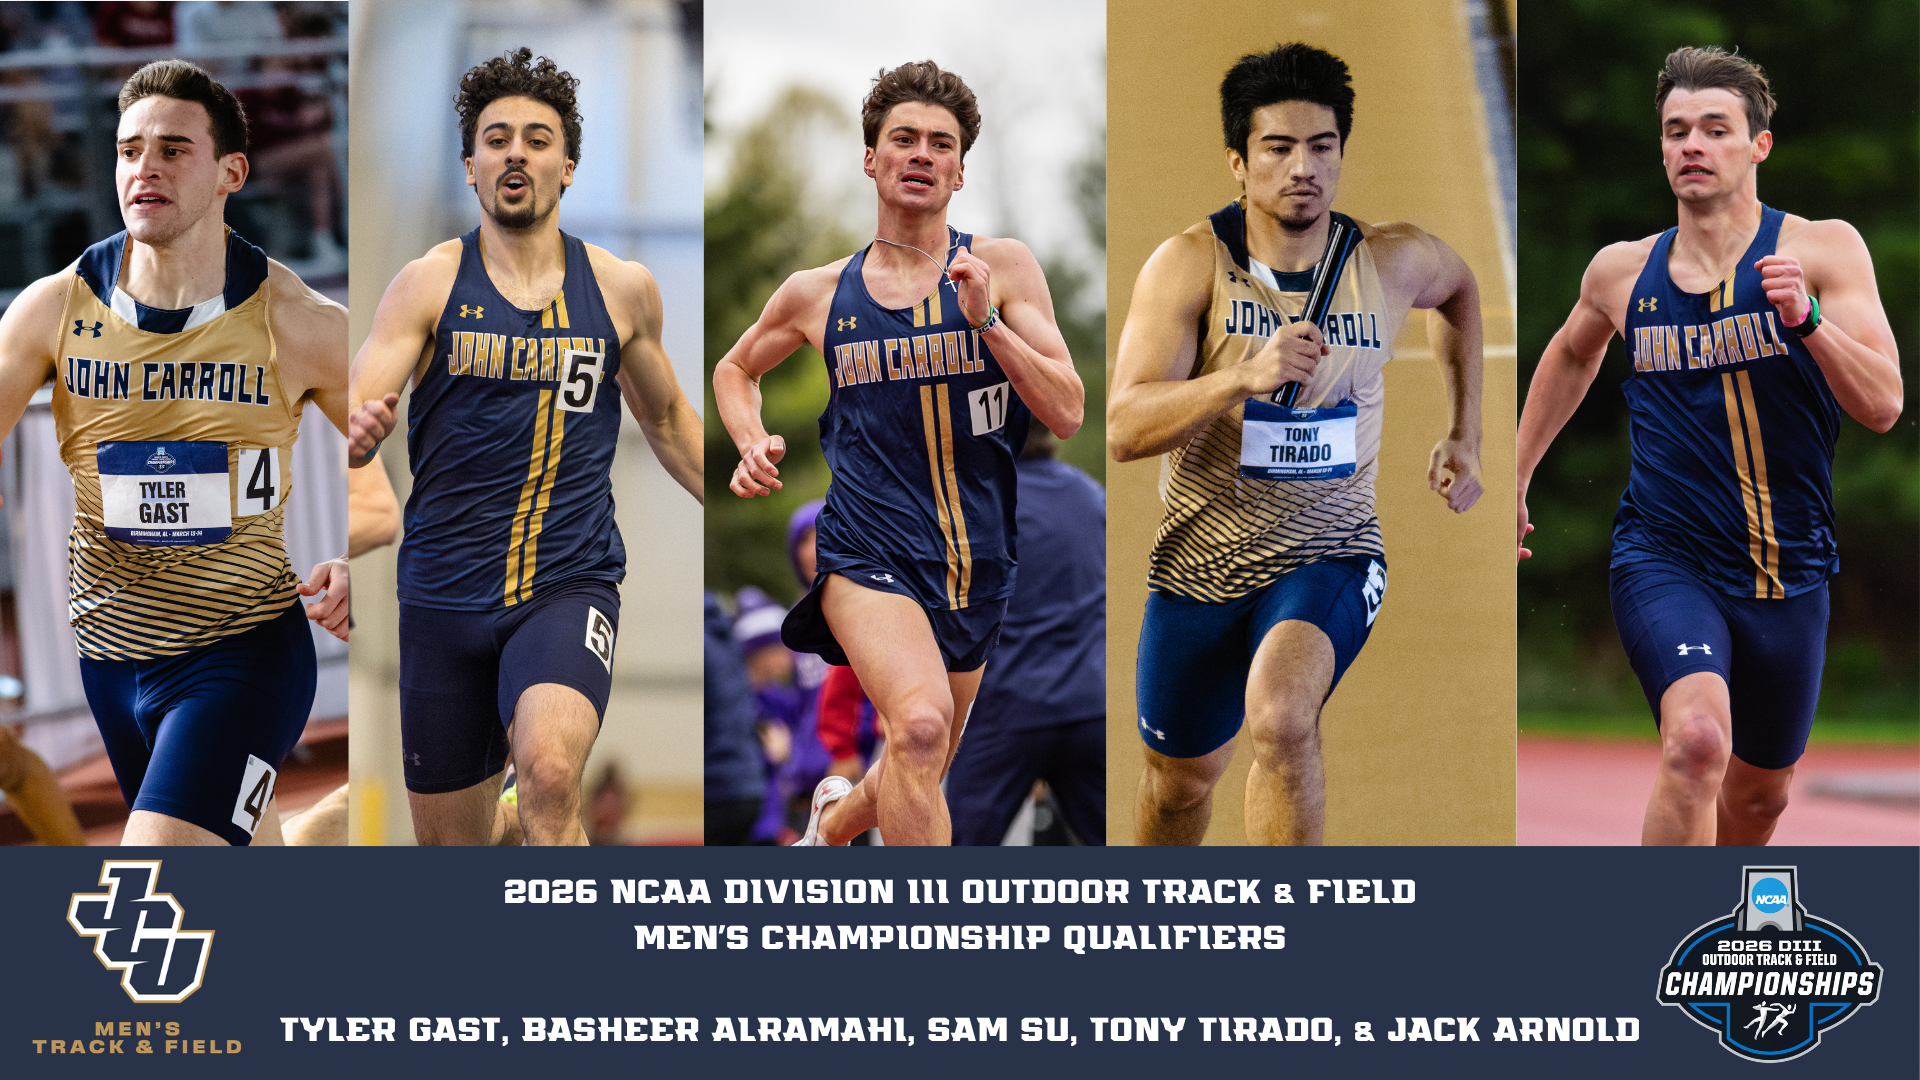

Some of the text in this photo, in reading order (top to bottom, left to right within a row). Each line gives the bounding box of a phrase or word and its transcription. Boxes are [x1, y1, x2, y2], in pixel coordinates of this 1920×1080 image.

[1225, 298, 1283, 339] JOHN
[1633, 311, 1788, 372] JOHN CARROLL
[448, 331, 506, 379] JOHN
[834, 329, 985, 388] JOHN CARROLL
[64, 356, 270, 406] JOHN CARROLL
[563, 354, 598, 408] 5
[978, 386, 1003, 431] 11
[1270, 443, 1331, 463] TIRADO
[1285, 427, 1320, 442] TONY
[138, 481, 186, 499] TYLER
[246, 448, 275, 511] 4
[139, 502, 190, 524] GAST
[592, 613, 611, 661] 5
[243, 769, 272, 832] 4
